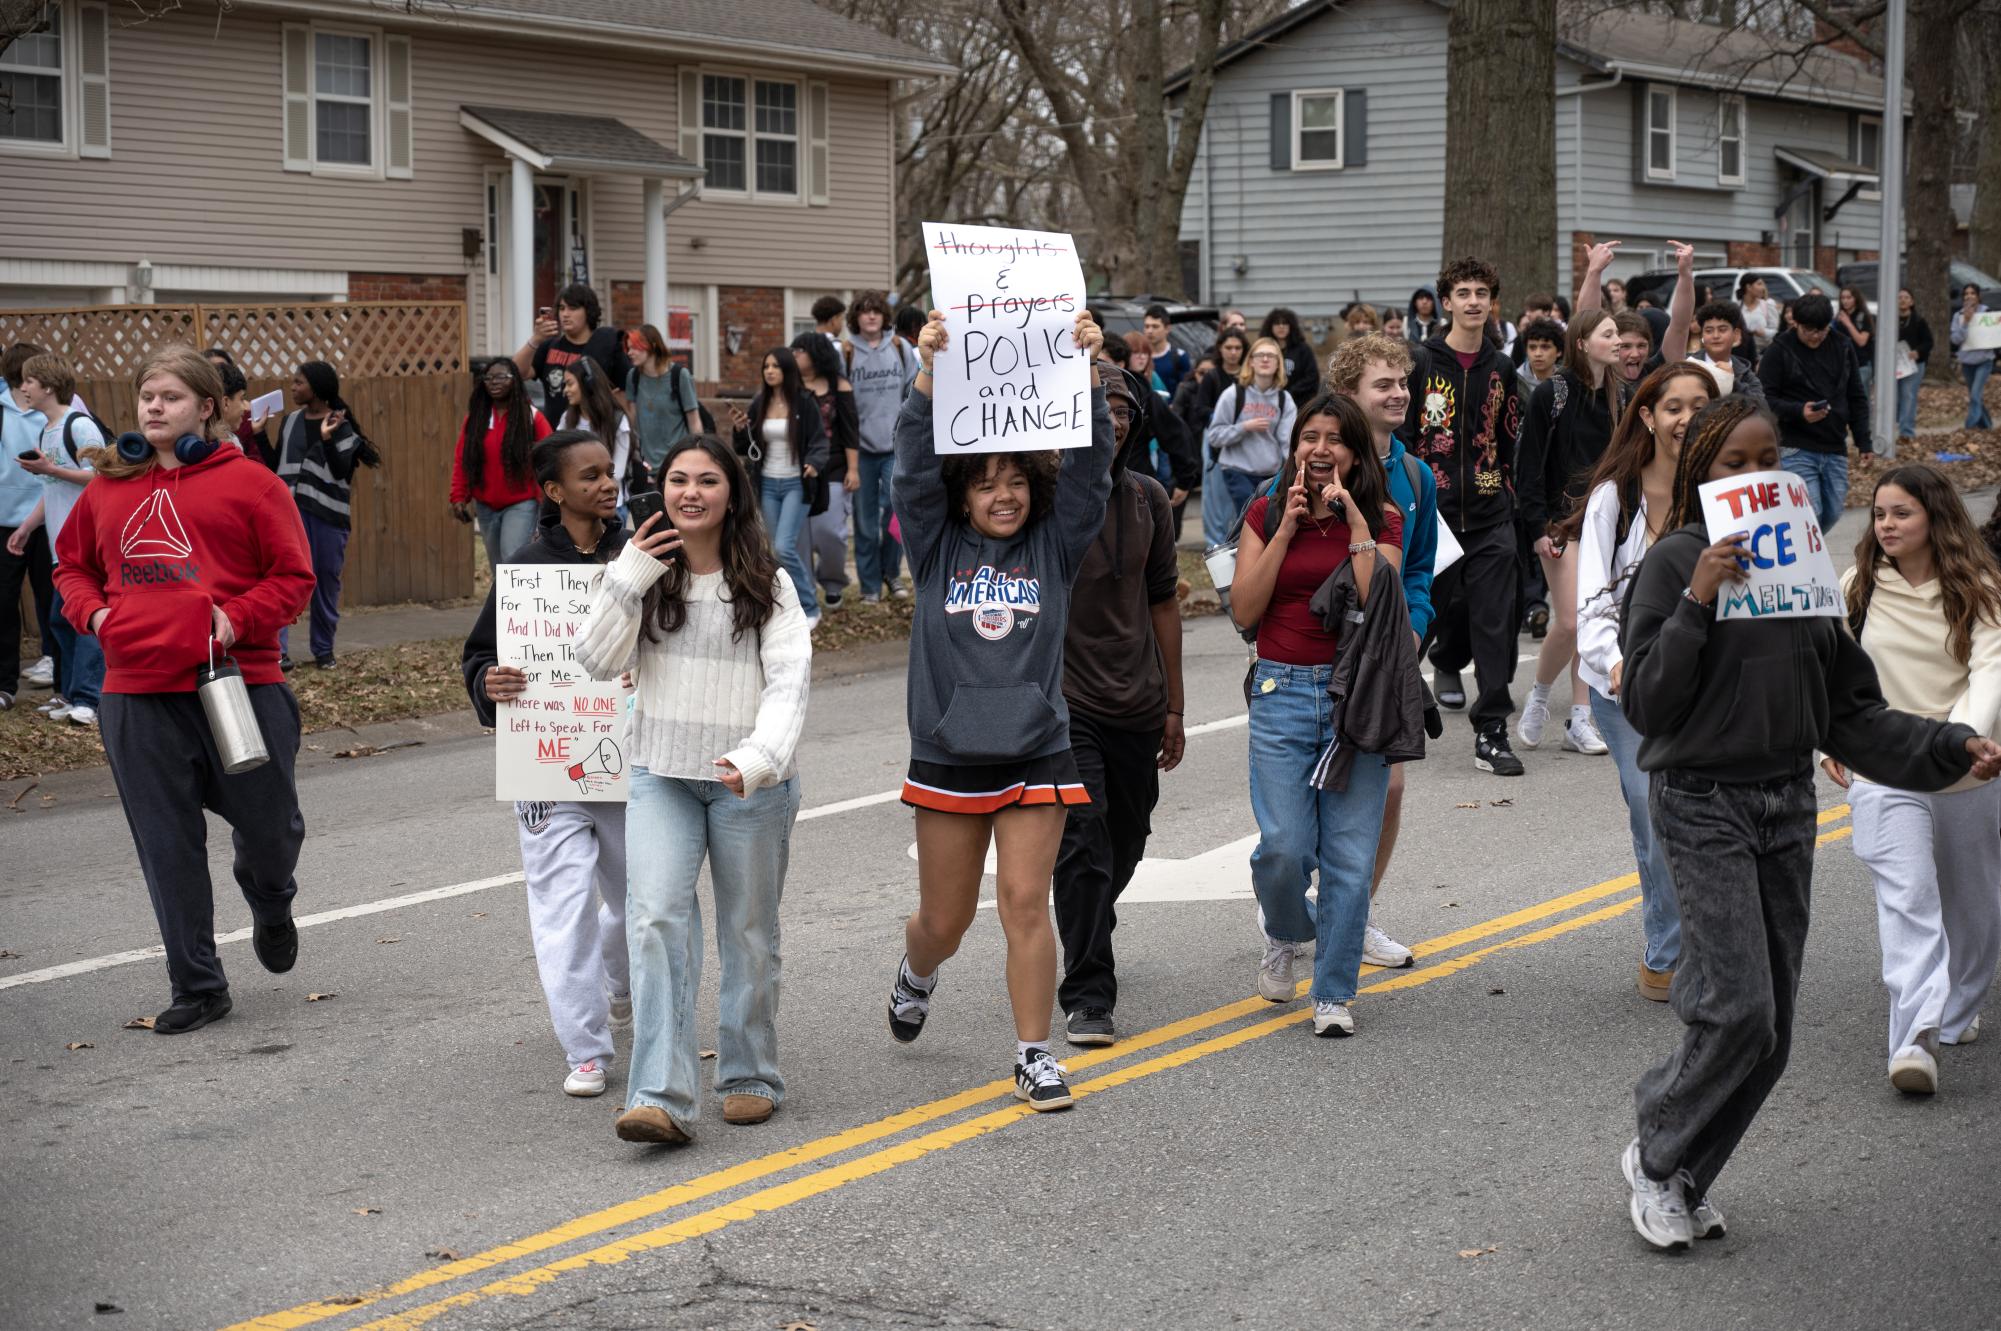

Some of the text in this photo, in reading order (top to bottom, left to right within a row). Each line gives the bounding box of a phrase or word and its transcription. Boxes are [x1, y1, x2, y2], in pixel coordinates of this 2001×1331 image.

[939, 231, 1058, 263] thoughts
[996, 269, 1011, 289] &
[979, 372, 1040, 400] and
[951, 391, 1085, 447] CHANGE
[1715, 481, 1781, 520] THE
[120, 560, 201, 587] Reebok
[555, 569, 588, 594] They
[974, 565, 1011, 586] ALL
[945, 576, 1040, 607] AMERICAN
[501, 595, 591, 615] For The Soc
[507, 617, 528, 636] And
[534, 619, 538, 637] I
[544, 620, 561, 637] Did
[558, 643, 576, 662] Th
[544, 700, 565, 711] was
[573, 696, 588, 711] NO
[593, 696, 617, 711] ONE
[510, 717, 614, 736] Left to Speak For
